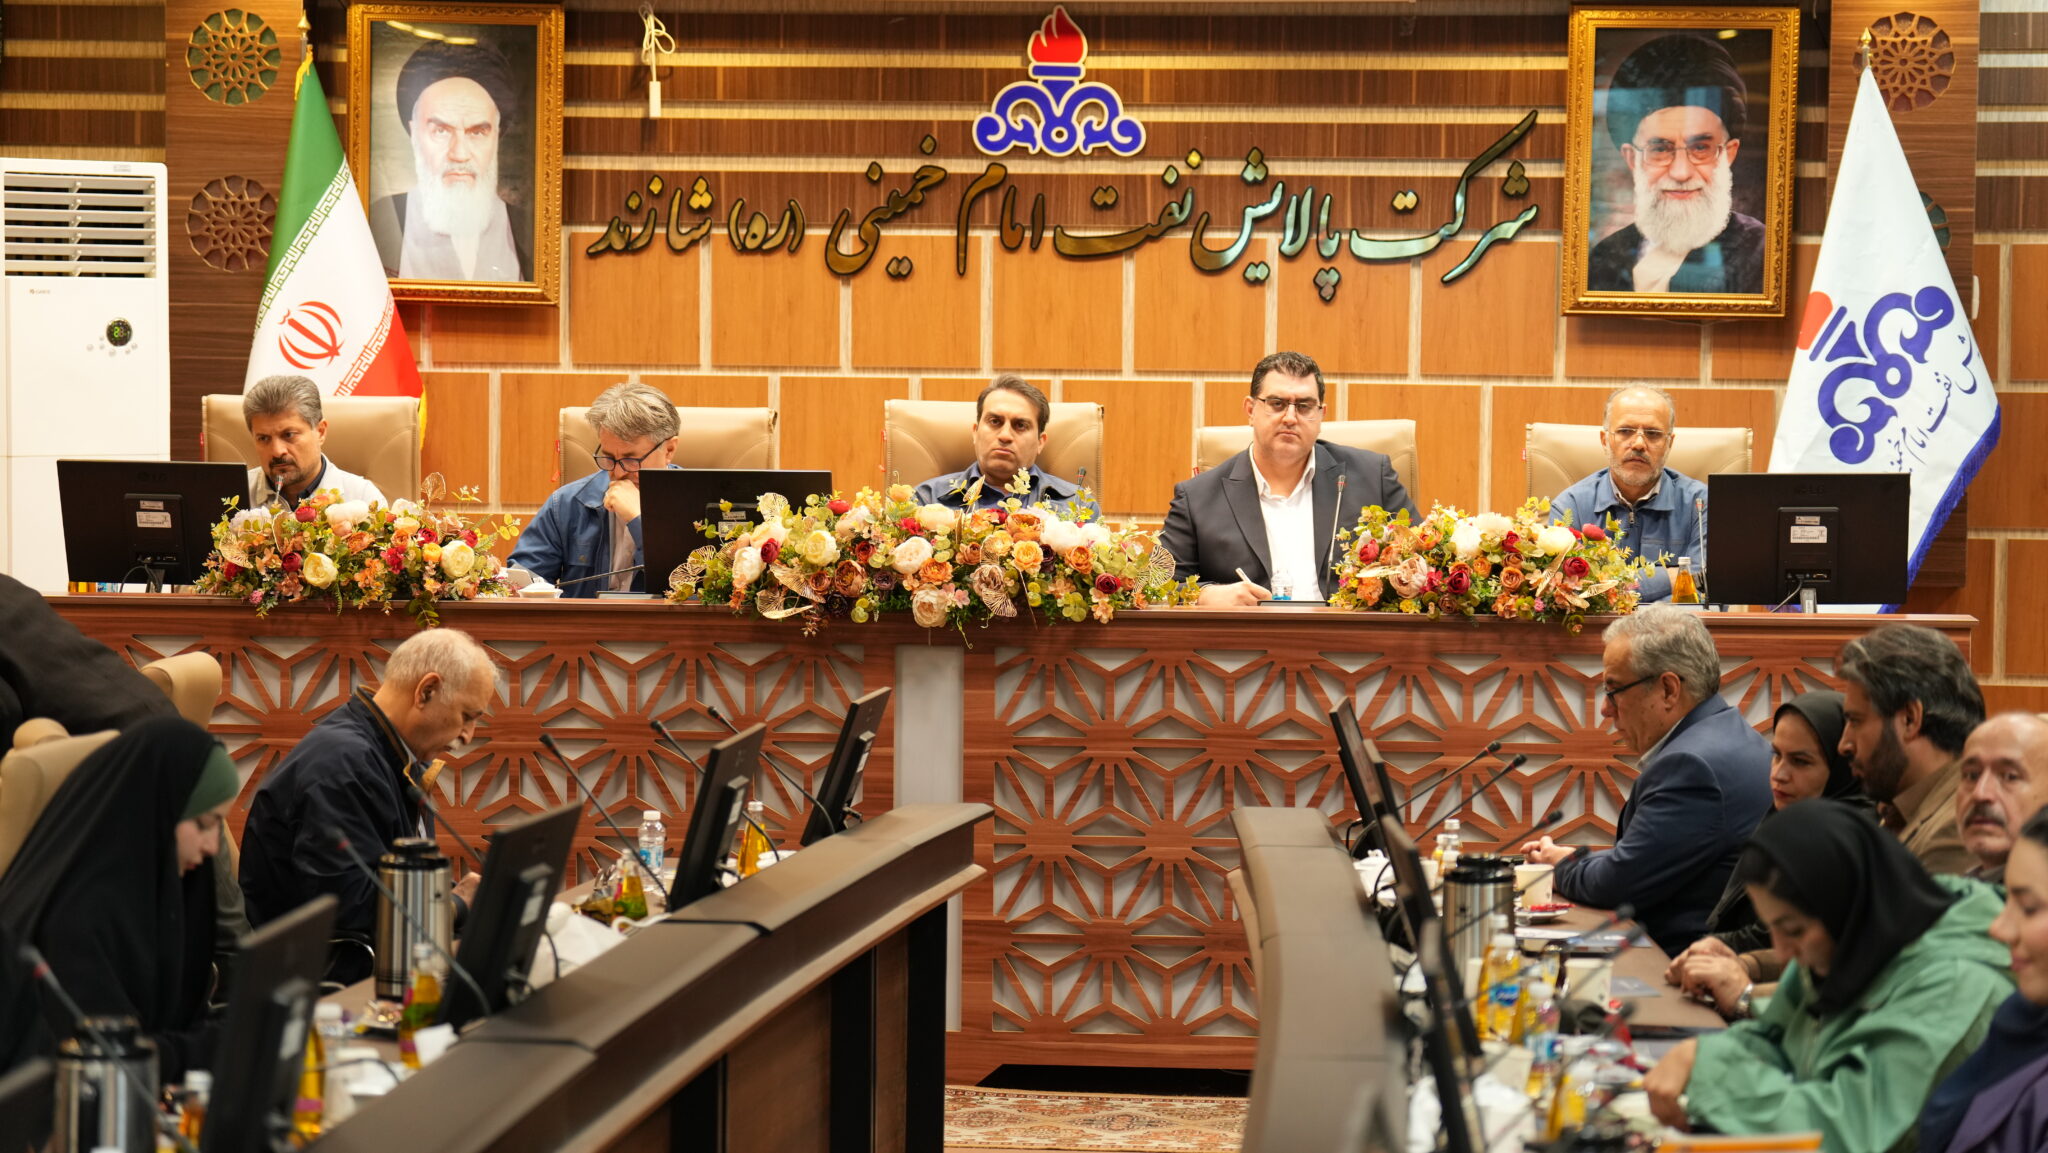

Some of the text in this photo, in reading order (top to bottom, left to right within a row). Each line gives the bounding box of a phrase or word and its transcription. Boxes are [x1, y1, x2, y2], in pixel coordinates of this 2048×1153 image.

[586, 110, 1538, 302] شرکت پالایش نفت امام خمینی (ره) شازند
